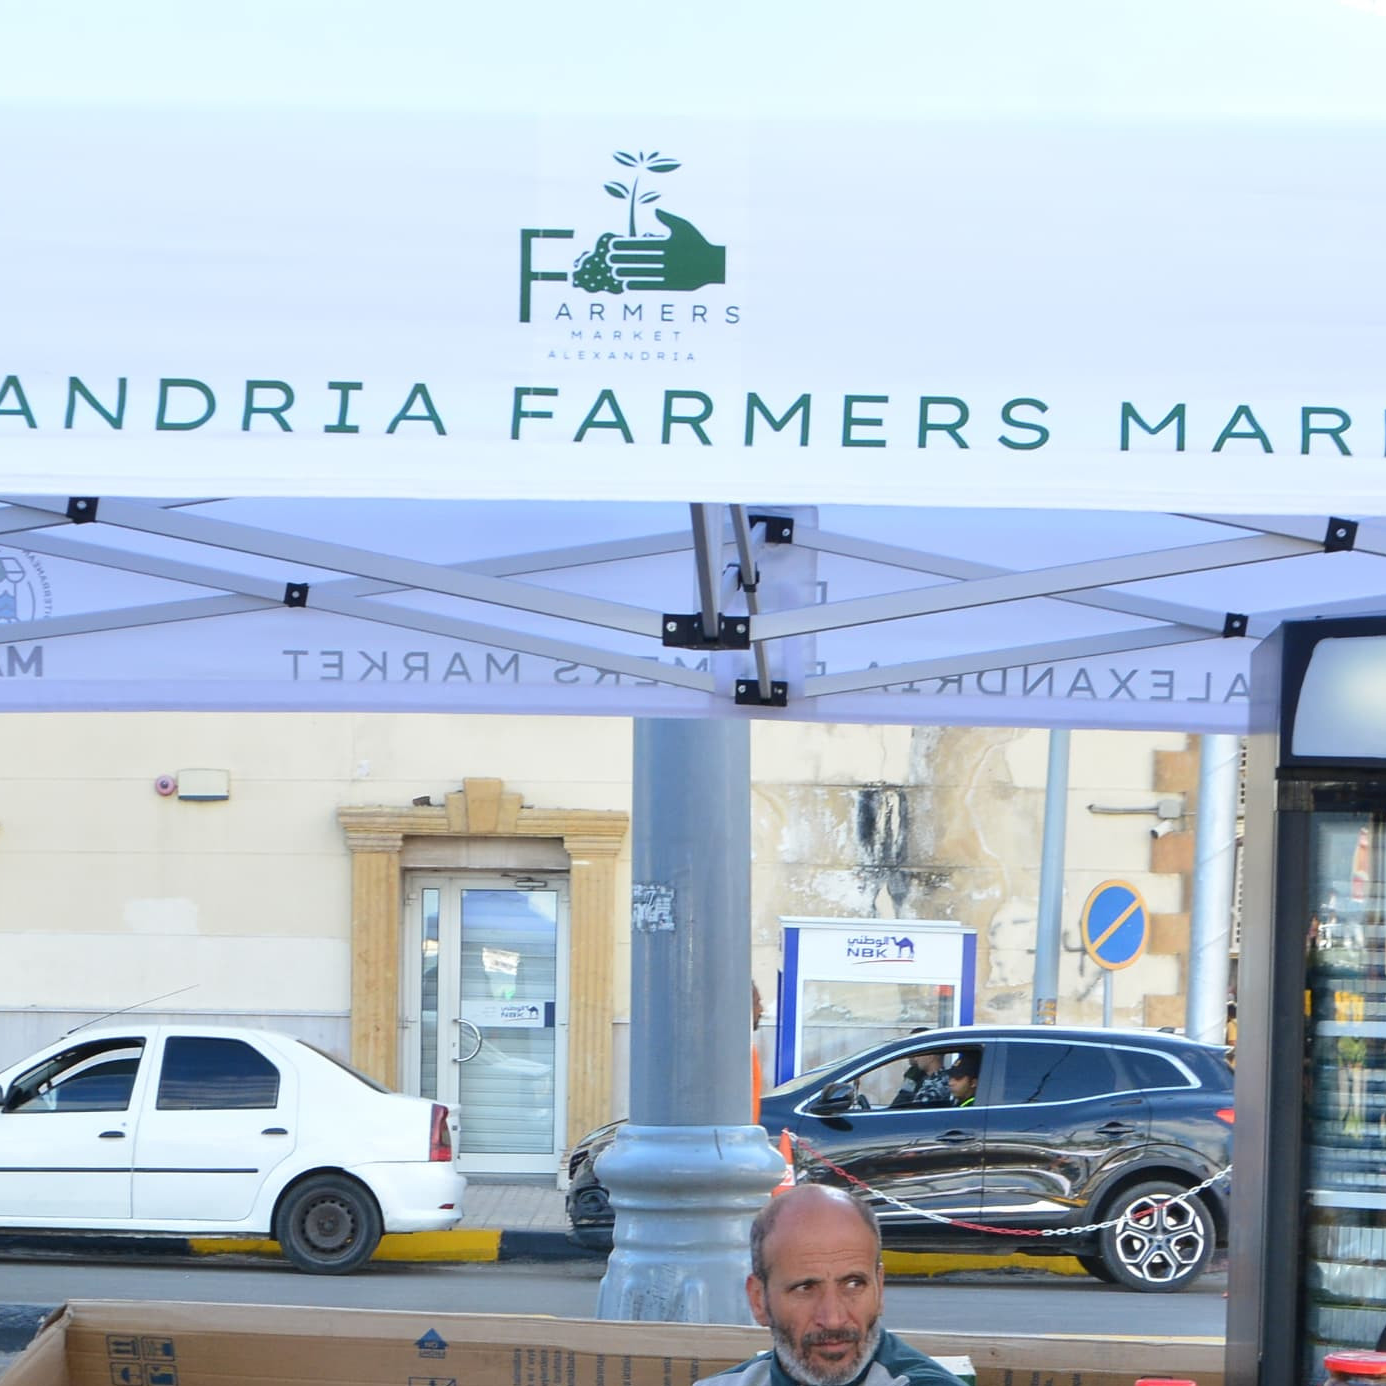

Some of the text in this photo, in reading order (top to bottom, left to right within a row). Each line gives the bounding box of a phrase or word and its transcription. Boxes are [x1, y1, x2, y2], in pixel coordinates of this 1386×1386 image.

[570, 331, 682, 342] MARKET
[547, 350, 696, 362] ALEXANDRIA
[510, 387, 1051, 450] FARMERS
[846, 947, 888, 958] NBK
